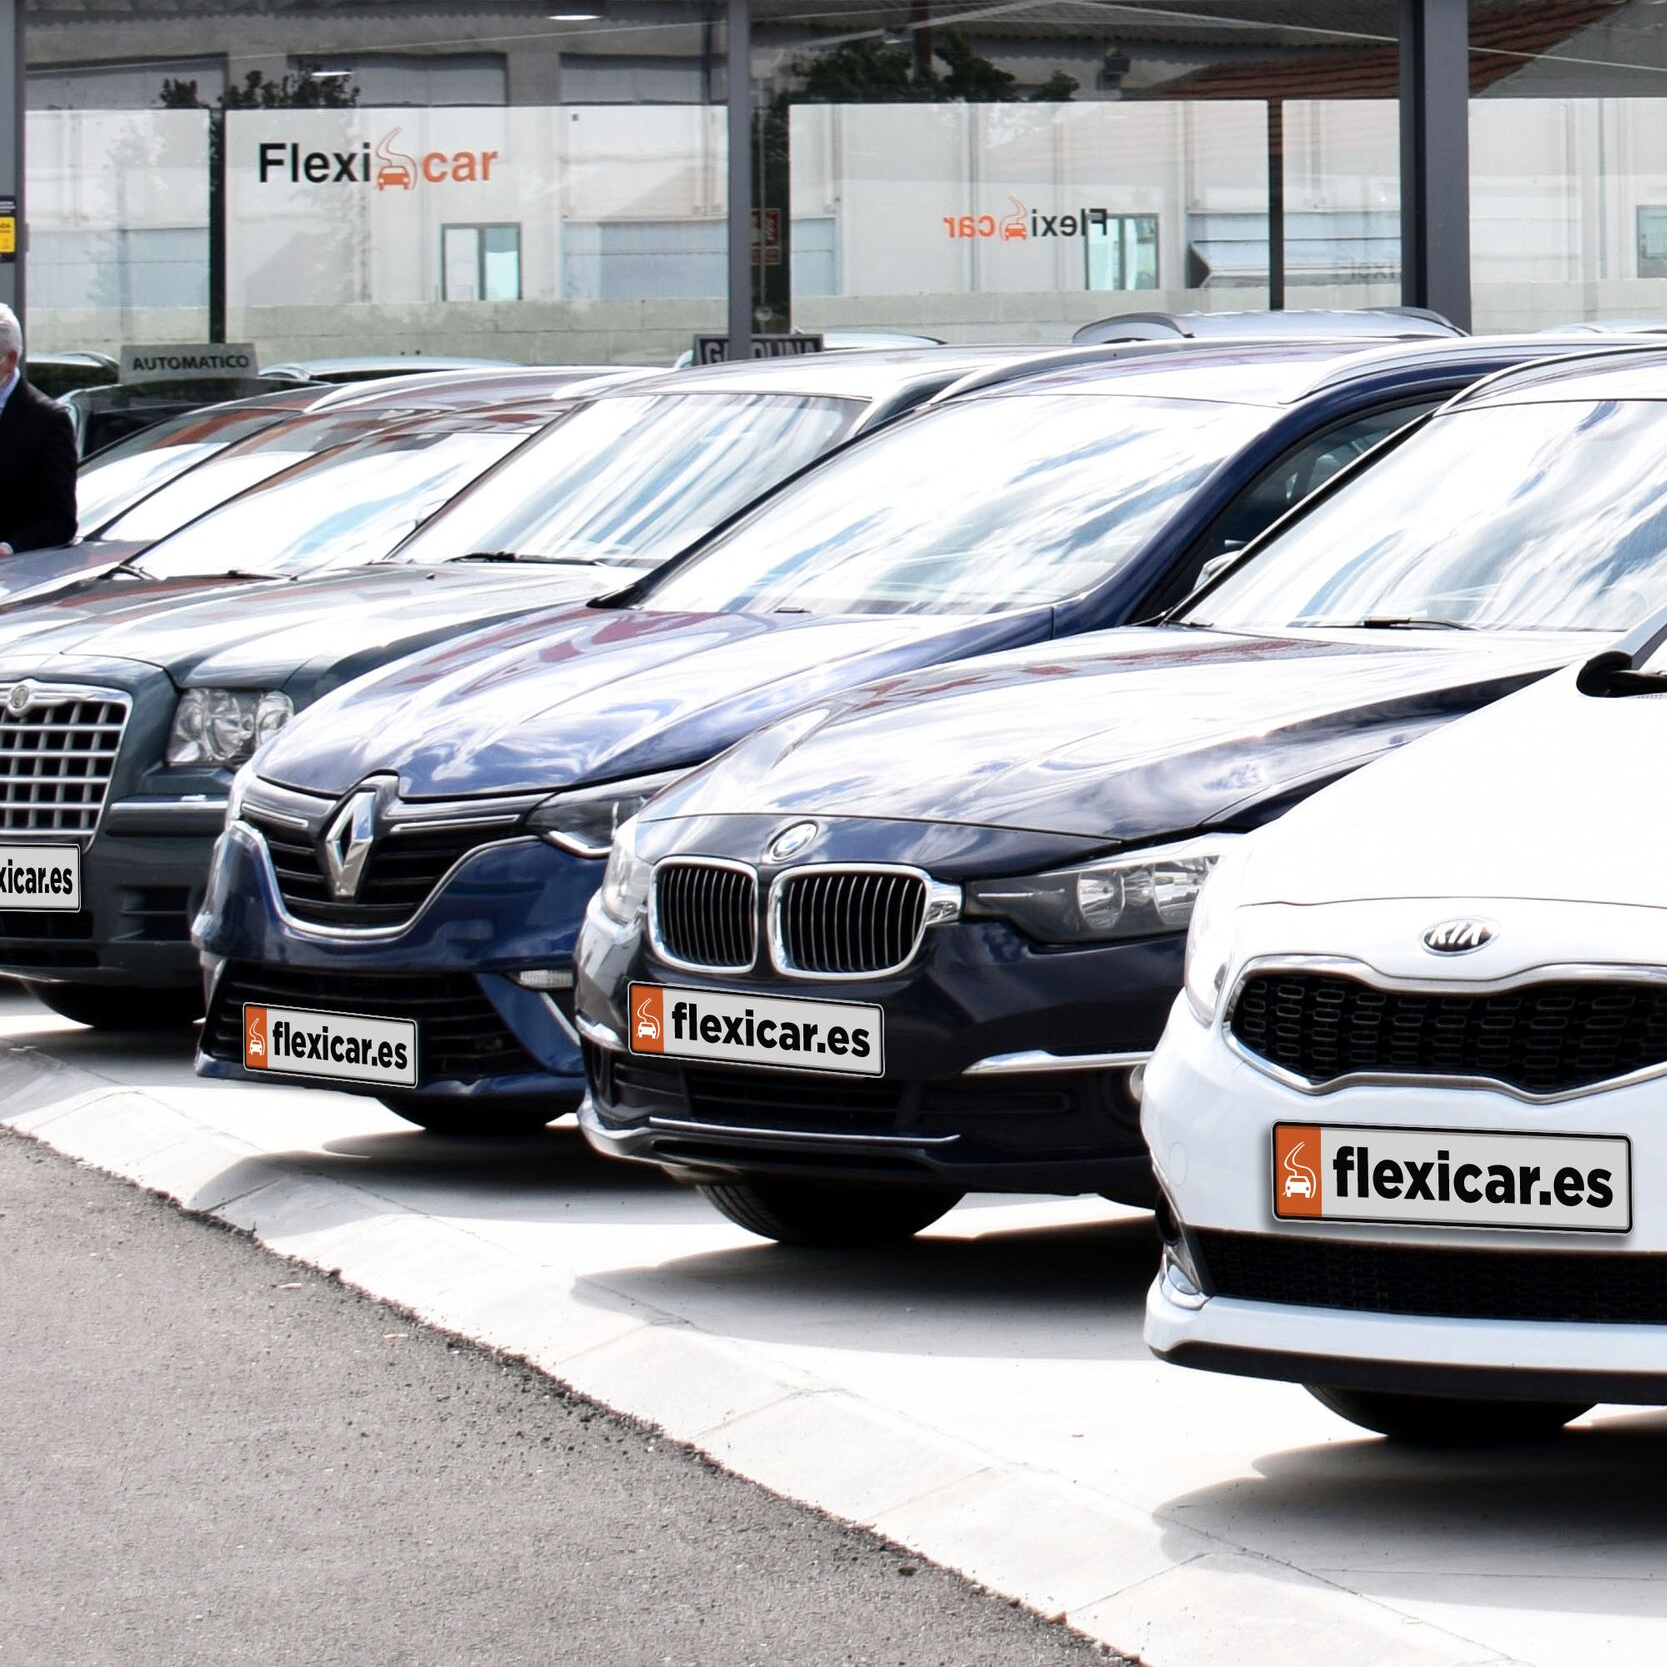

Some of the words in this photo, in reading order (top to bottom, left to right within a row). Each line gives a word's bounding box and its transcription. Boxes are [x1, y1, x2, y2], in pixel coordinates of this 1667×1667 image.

[259, 142, 372, 184] Flexi
[422, 149, 499, 183] car
[132, 354, 250, 371] AUTOMATICO
[1428, 921, 1485, 946] KIA
[271, 1020, 408, 1070] flexicar.es
[671, 1001, 871, 1058] flexicar.es
[1332, 1145, 1614, 1209] flexicar.es
